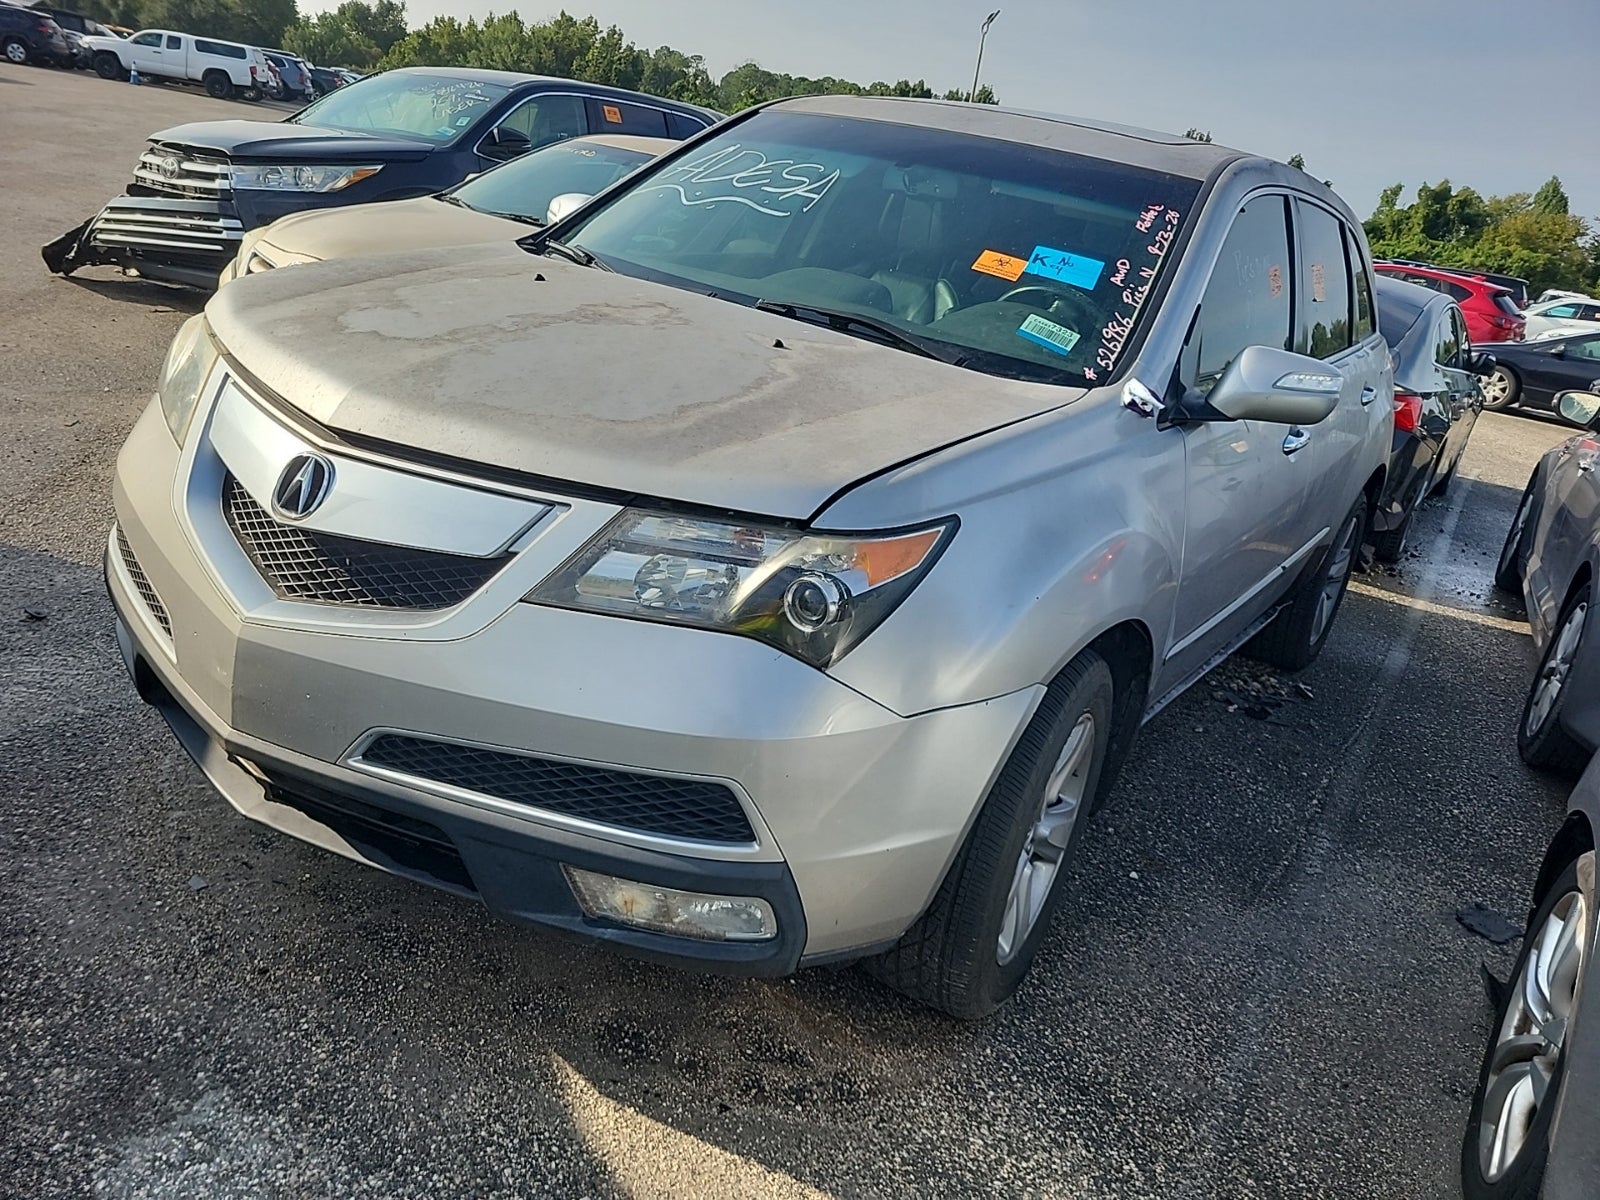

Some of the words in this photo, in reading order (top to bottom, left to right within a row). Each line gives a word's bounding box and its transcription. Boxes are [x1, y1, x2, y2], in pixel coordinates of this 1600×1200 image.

[661, 143, 840, 213] ADESA
[1110, 258, 1130, 287] AWD
[1083, 366, 1098, 381] #
[1097, 312, 1134, 371] 526986
